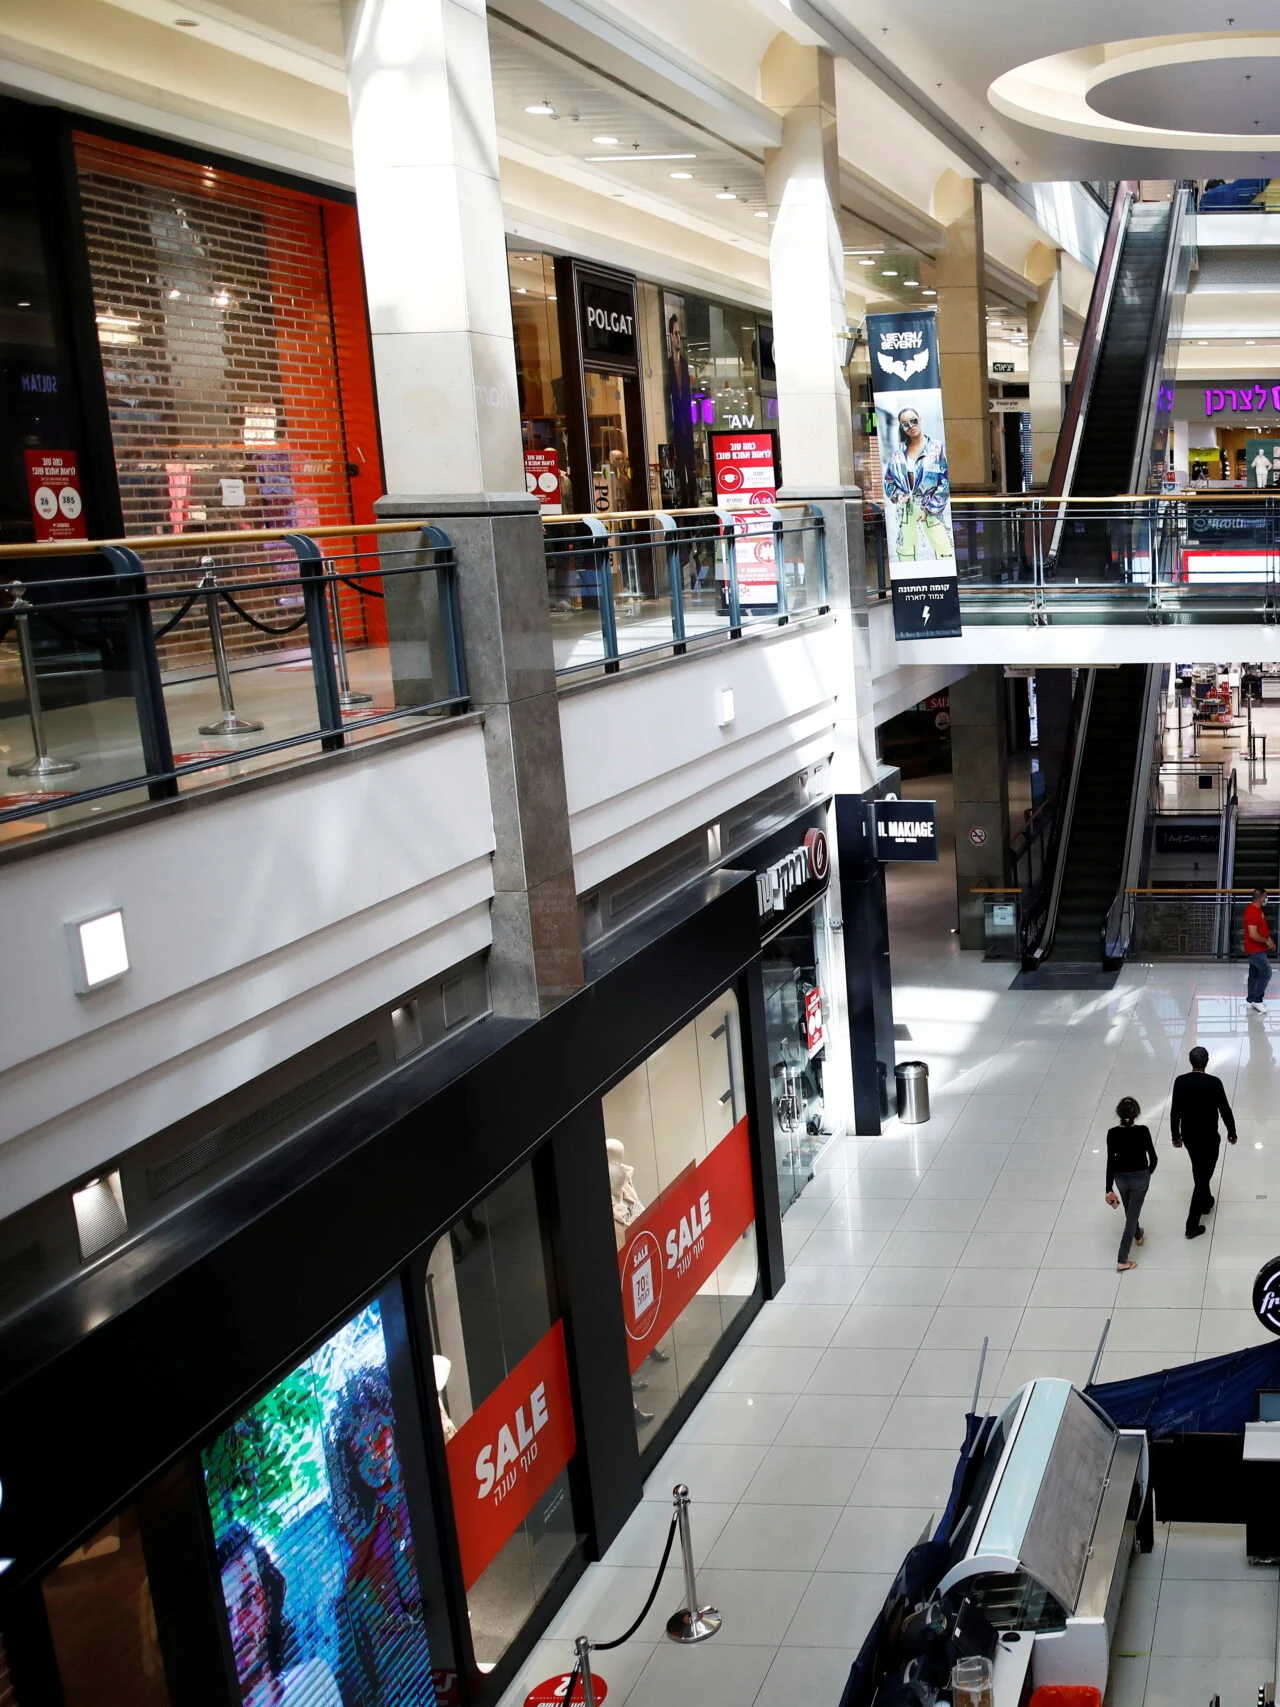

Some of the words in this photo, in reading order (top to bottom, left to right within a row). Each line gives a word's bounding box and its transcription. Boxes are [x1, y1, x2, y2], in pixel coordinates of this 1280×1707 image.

[587, 306, 633, 336] POLGAT
[881, 340, 923, 350] SEVENTY
[885, 331, 917, 342] SEVEN
[1205, 384, 1267, 416] לצרכן
[730, 442, 742, 451] טוב
[743, 442, 756, 450] כמה
[732, 451, 751, 460] אתכם
[752, 450, 771, 460] לראות
[40, 497, 49, 505] 26
[898, 585, 927, 594] תחתונה
[929, 584, 950, 592] קומה
[905, 593, 926, 601] לזארה
[878, 822, 887, 837] IL
[888, 821, 934, 838] MAKIAGE
[665, 1189, 712, 1270] SALE
[633, 1244, 649, 1268] SALE
[692, 1236, 705, 1260] סוף
[677, 1251, 692, 1279] עונה
[637, 1287, 650, 1307] הנחה
[475, 1381, 549, 1499] SALE
[520, 1441, 538, 1473] סוף
[494, 1466, 517, 1507] עונה
